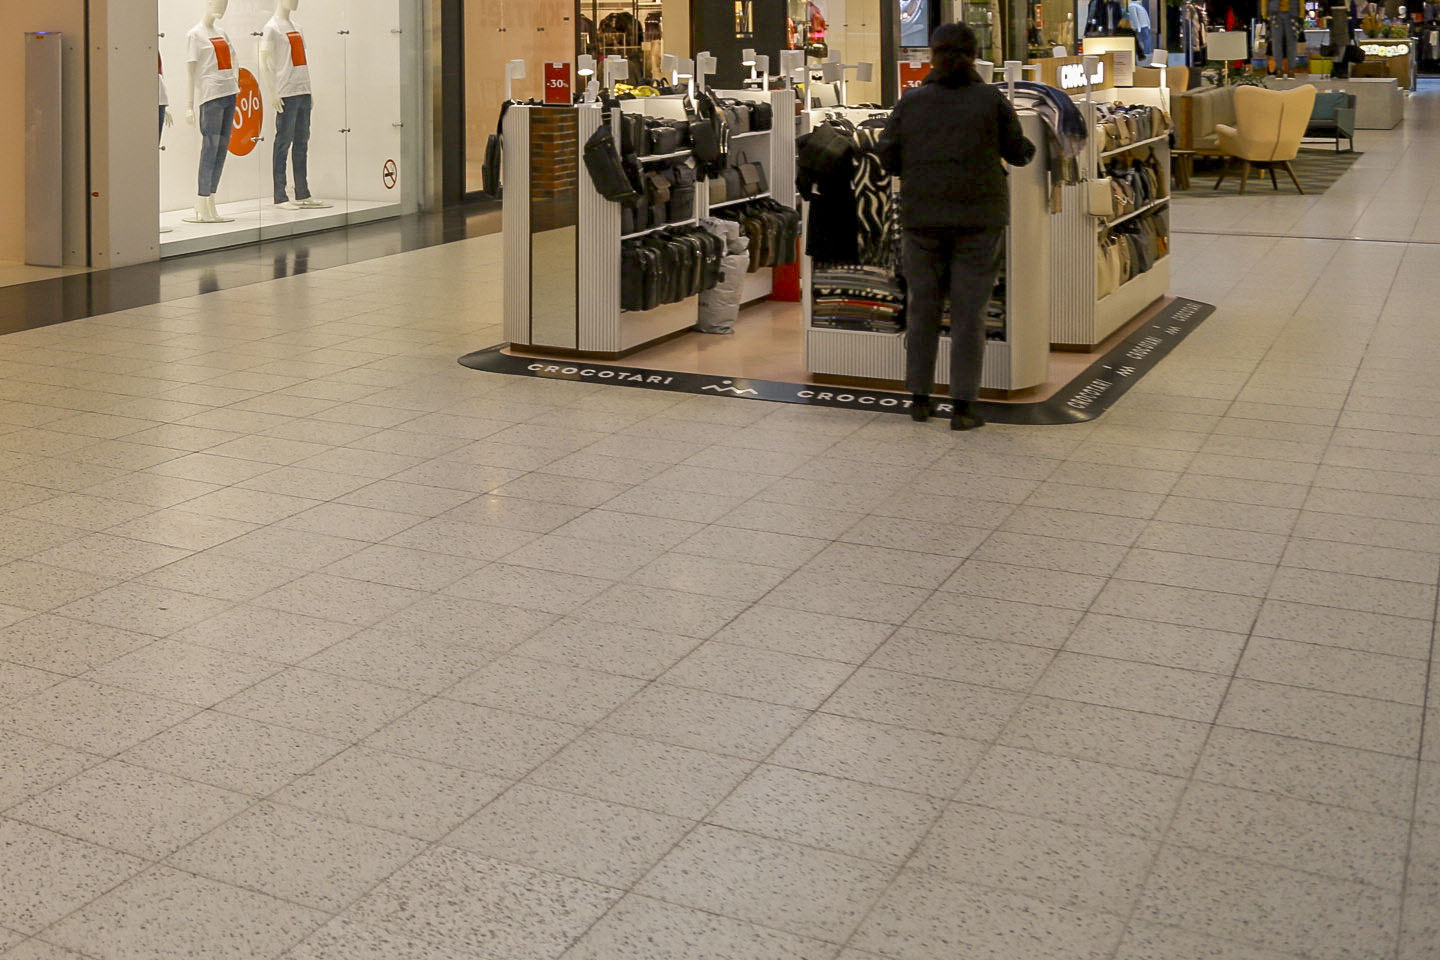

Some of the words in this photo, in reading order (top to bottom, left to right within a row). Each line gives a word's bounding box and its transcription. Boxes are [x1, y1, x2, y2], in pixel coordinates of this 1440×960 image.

[902, 80, 922, 88] -30
[527, 363, 675, 385] CROCOTARI
[796, 390, 954, 413] CROCOTR
